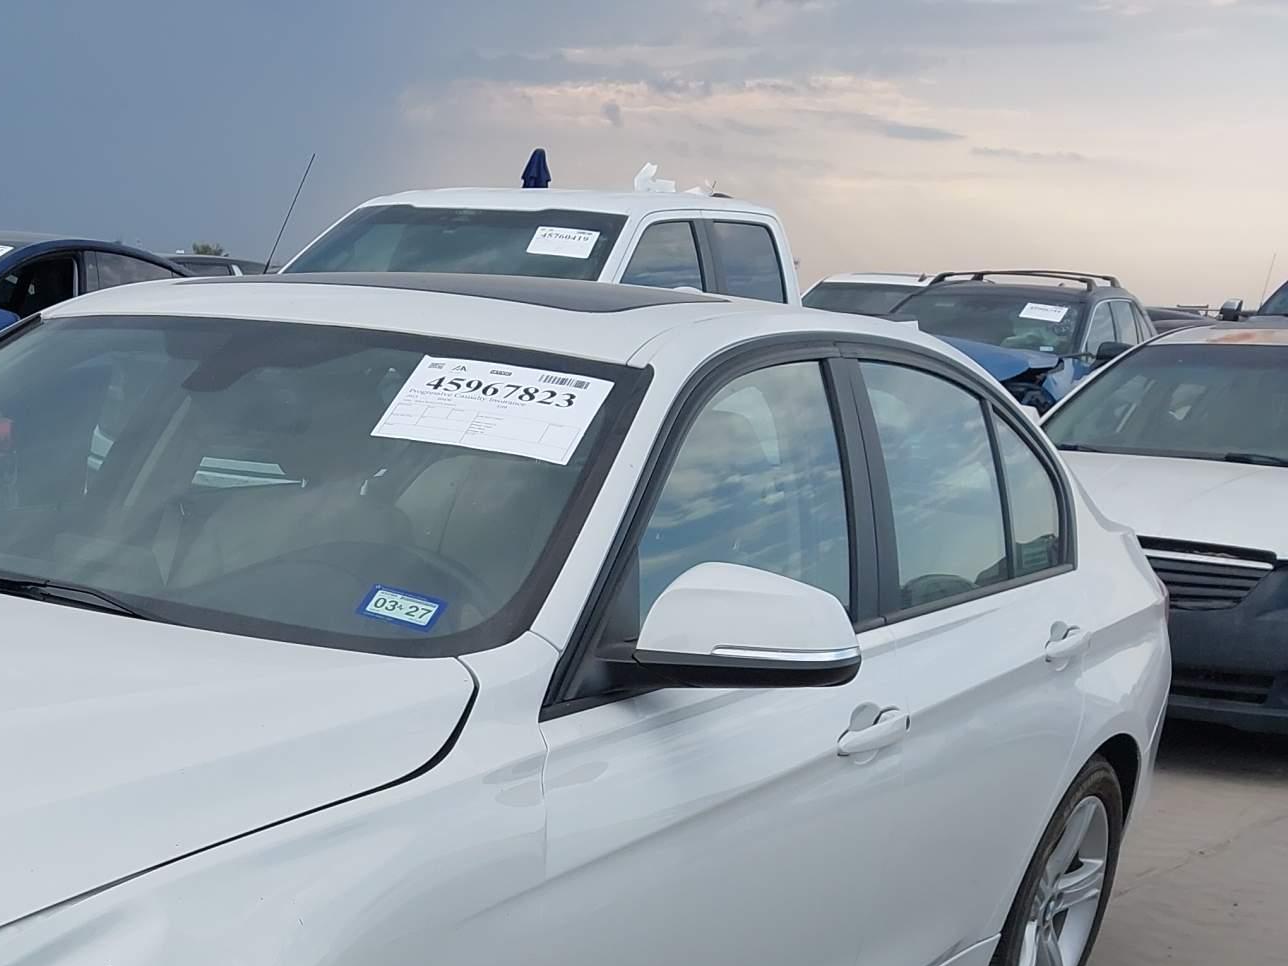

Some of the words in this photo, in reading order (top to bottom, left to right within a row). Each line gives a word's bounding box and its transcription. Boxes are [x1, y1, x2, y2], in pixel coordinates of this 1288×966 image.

[426, 376, 576, 408] 45967823
[374, 597, 398, 611] 03
[405, 605, 432, 619] 27
